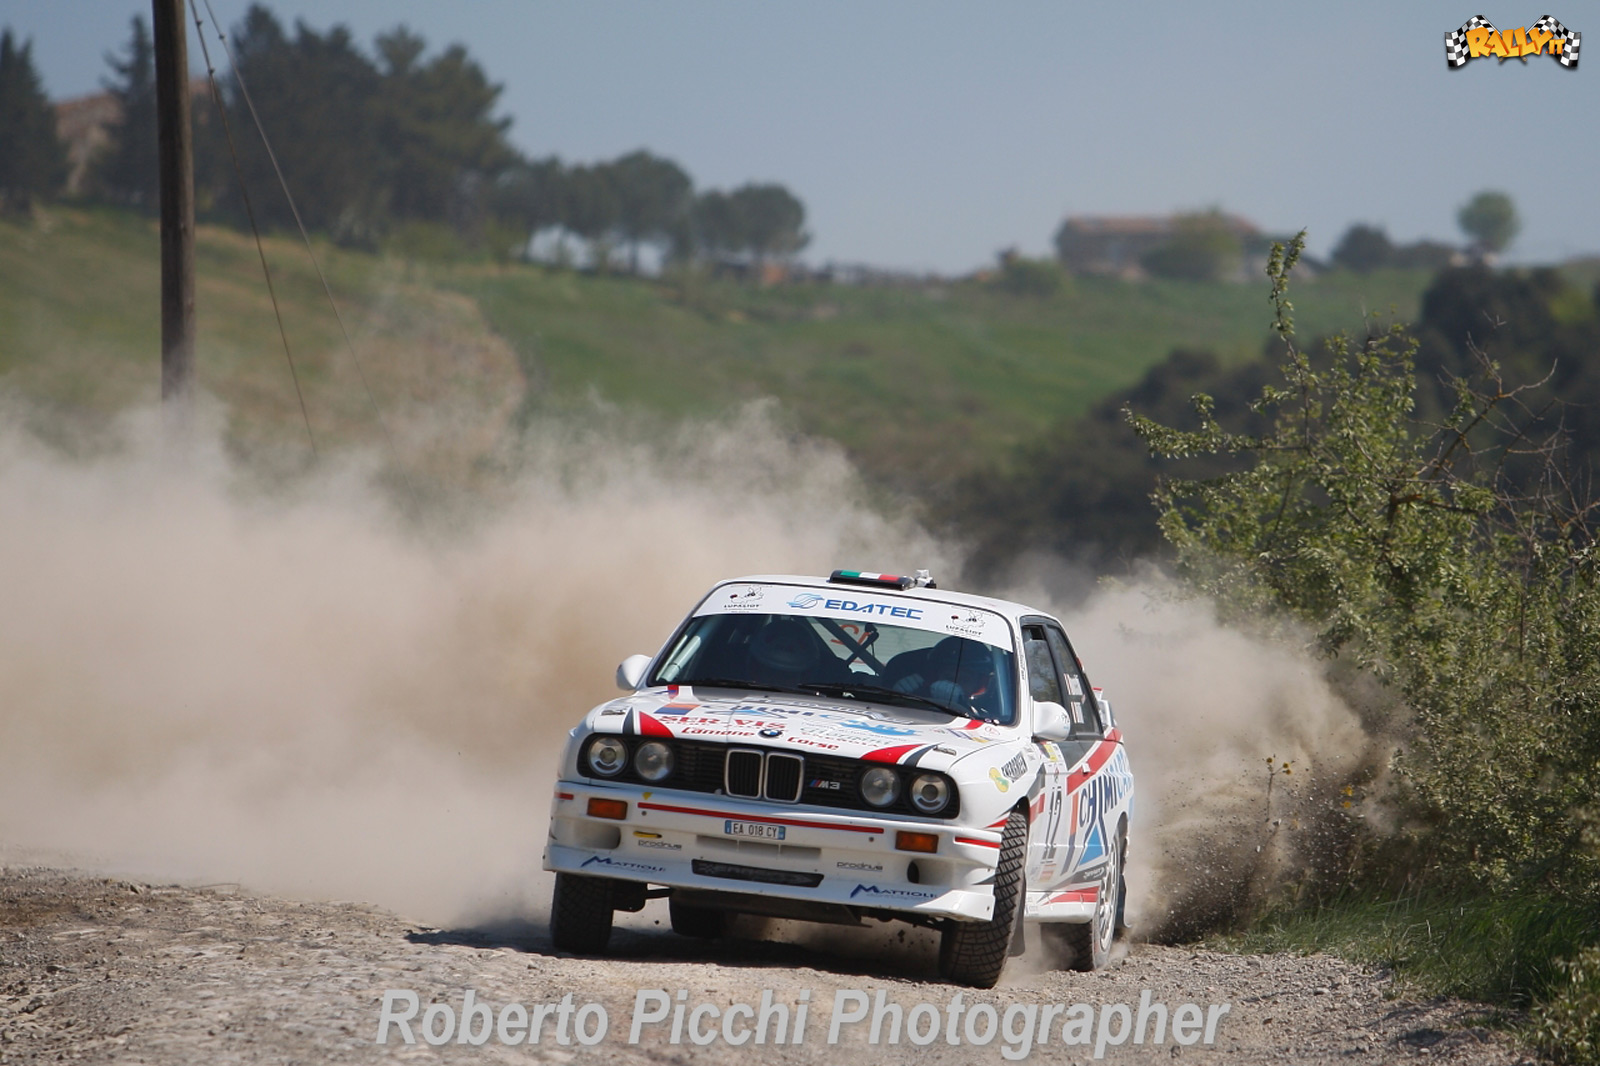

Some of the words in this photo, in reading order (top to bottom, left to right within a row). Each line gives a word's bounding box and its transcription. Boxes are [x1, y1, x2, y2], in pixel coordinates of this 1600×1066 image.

[824, 599, 923, 620] EDATEC
[817, 780, 841, 790] M3
[733, 823, 744, 834] EA
[748, 824, 763, 836] 018
[766, 826, 778, 838] CY
